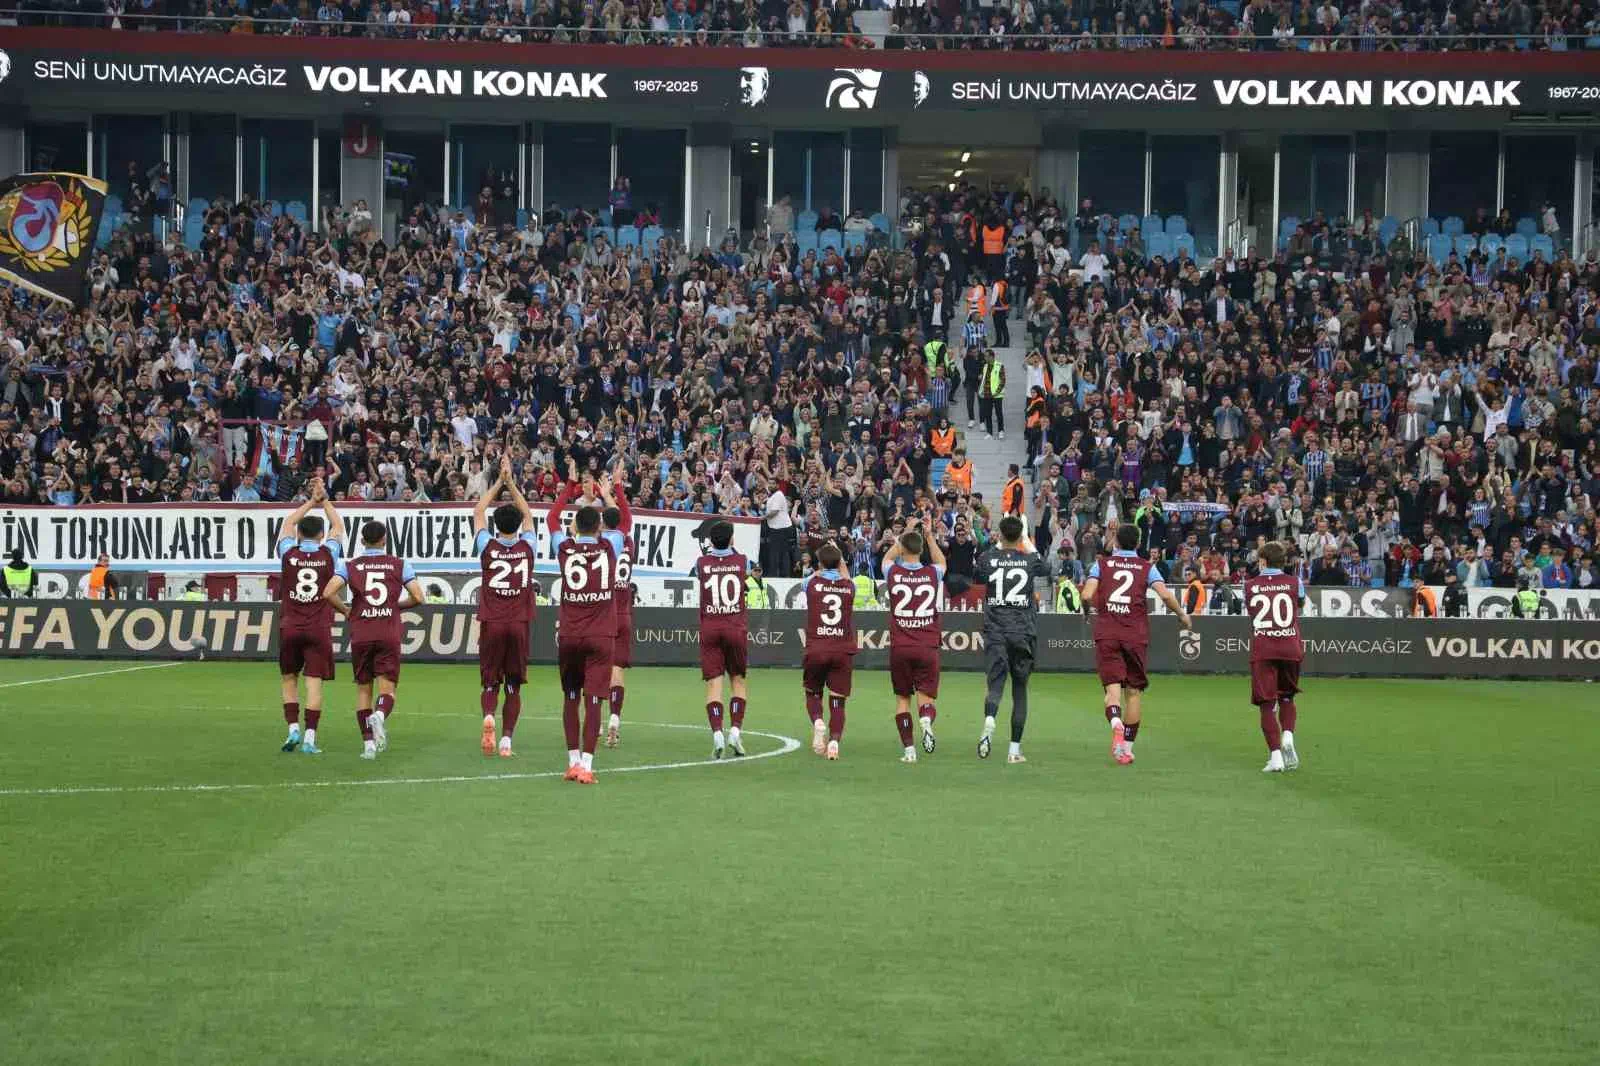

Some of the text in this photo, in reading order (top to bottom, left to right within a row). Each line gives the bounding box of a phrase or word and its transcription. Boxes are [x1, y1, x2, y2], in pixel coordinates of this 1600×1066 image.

[34, 57, 699, 99] SENİ UNUTMAYACAĞIZ VOLKAN KONAK 1967-2025
[952, 77, 1600, 106] SENİ UNUTMAYACAĞIZ VOLKAN KONAK 1967-20
[296, 567, 319, 599] 8
[488, 558, 529, 589] 21
[564, 551, 610, 590] 61
[988, 567, 1029, 602] 12
[1108, 569, 1134, 604] 2
[365, 571, 388, 606] 5
[704, 573, 741, 607] 10
[891, 583, 936, 617] 22
[820, 593, 842, 626] 3
[1106, 603, 1131, 614] TAHA
[1250, 592, 1294, 629] 20
[91, 607, 273, 652] YOUTH
[1425, 636, 1553, 659] VOLKAN
